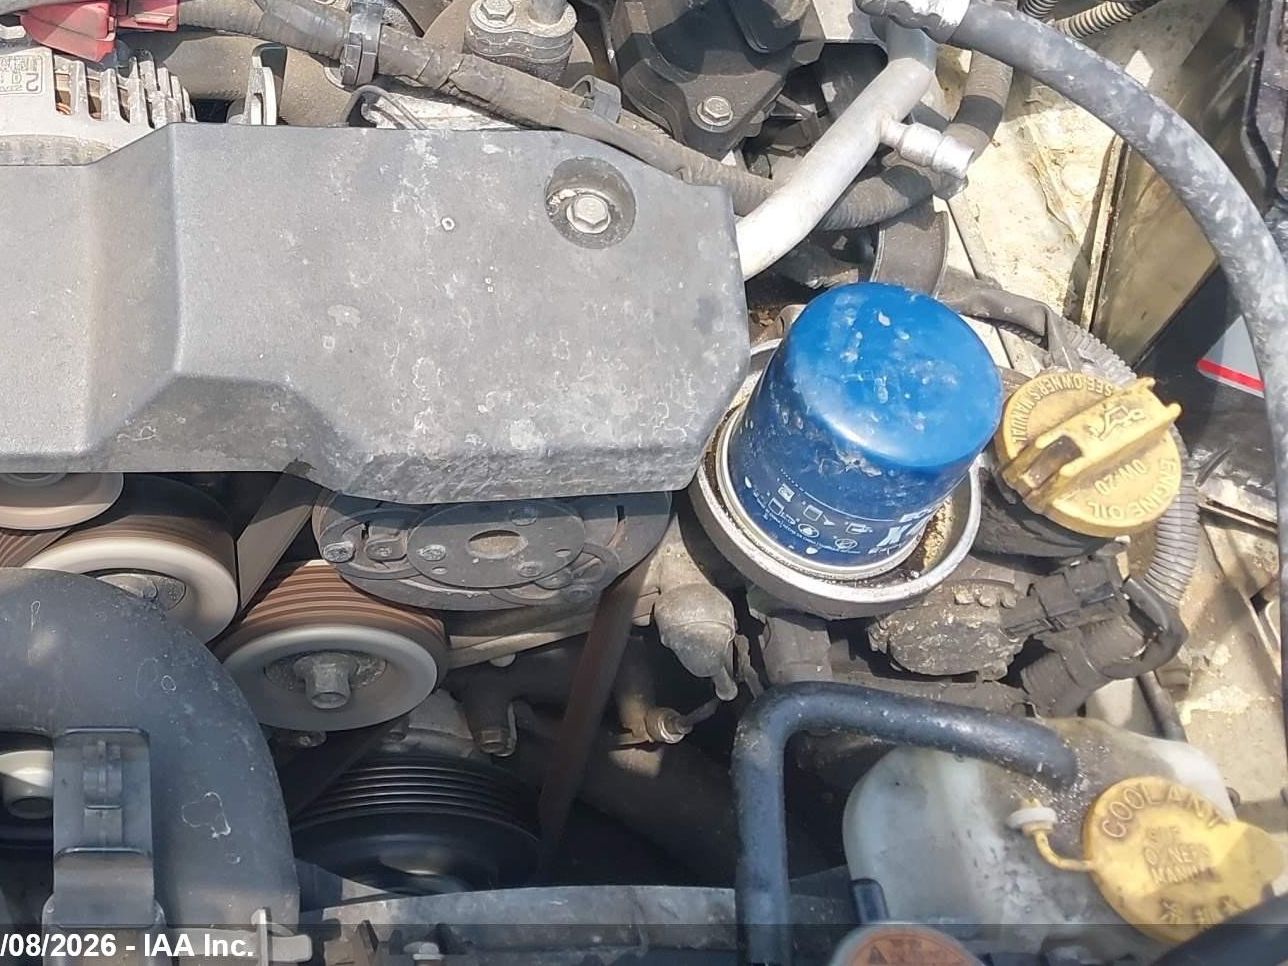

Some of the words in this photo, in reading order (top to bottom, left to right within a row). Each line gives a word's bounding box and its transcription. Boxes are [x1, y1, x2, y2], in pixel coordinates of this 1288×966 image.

[25, 73, 40, 92] 2
[1033, 375, 1084, 402] OWNER'S
[1086, 376, 1114, 398] SEE
[1010, 393, 1035, 443] MANUAL
[1127, 456, 1178, 517] ENGINE
[1086, 500, 1125, 521] OIL
[1100, 782, 1231, 839] COOLANT
